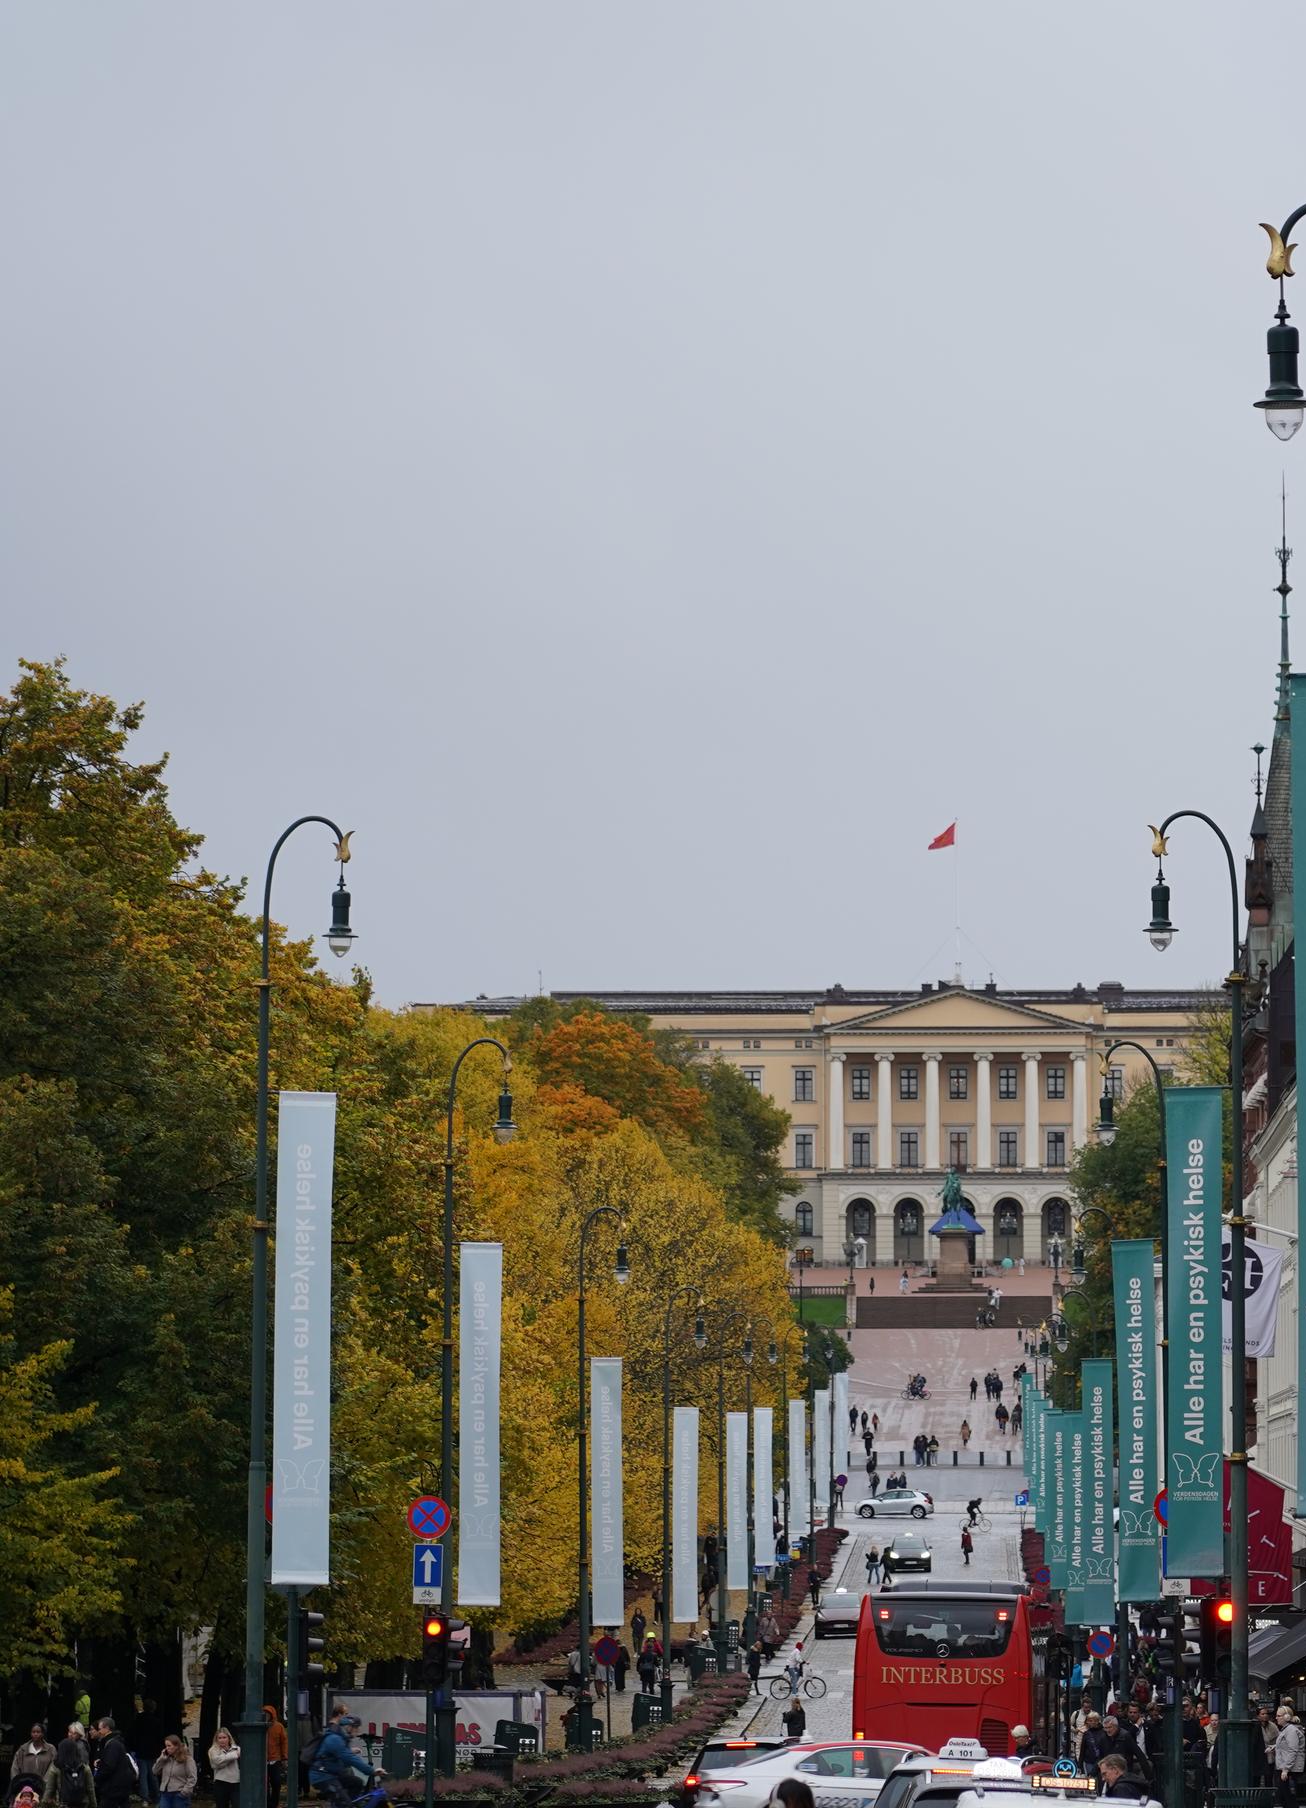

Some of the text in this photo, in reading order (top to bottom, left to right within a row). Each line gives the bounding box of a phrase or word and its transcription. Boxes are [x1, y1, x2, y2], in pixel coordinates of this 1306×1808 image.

[1183, 1138, 1209, 1445] Alle har en psykisk helse
[1090, 1386, 1106, 1555] Alle har en psykisk helse
[1125, 1277, 1146, 1505] Alle har en psykisk helse
[881, 1666, 1006, 1686] INTERBUSS
